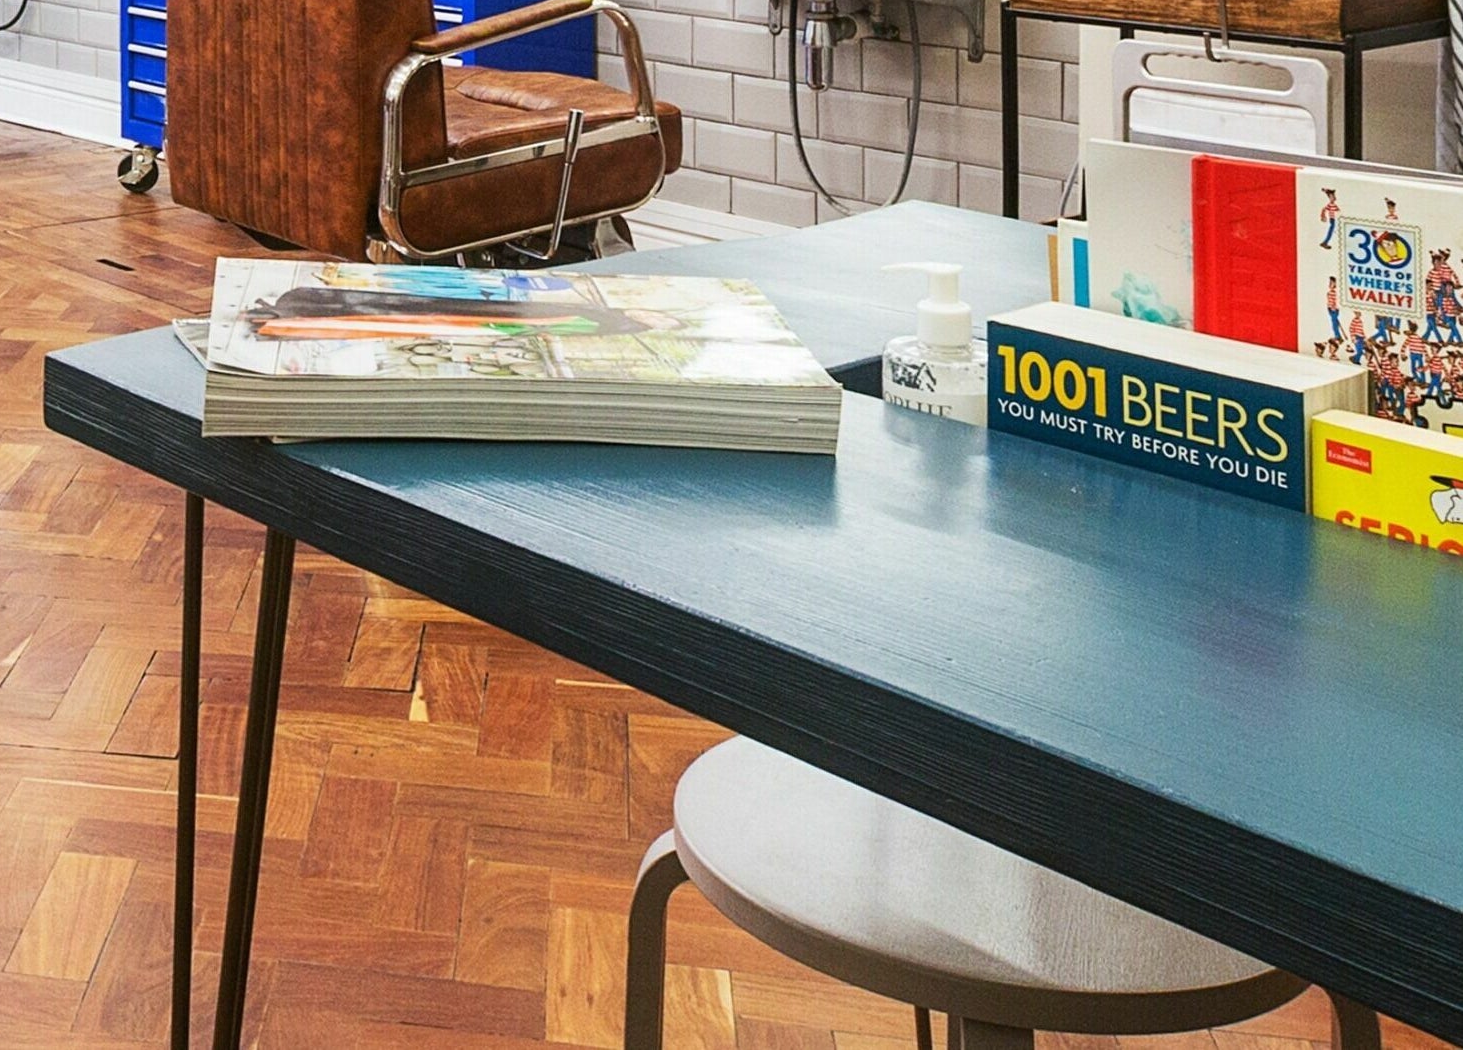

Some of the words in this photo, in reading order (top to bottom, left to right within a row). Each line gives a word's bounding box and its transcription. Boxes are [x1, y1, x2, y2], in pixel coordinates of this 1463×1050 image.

[1348, 229, 1412, 269] 30
[1348, 264, 1390, 278] YEARS
[1395, 271, 1413, 281] OF
[1348, 275, 1413, 294] WHERE'S
[1349, 287, 1413, 308] WALLY?
[997, 345, 1107, 418] 1001
[1122, 374, 1288, 462] BEERS
[998, 398, 1034, 420] YOU
[1040, 409, 1088, 435] MUST
[1092, 423, 1125, 445] TRY
[1131, 433, 1200, 466] BEFORE
[1205, 452, 1248, 478] YOU
[1255, 466, 1288, 489] DIE
